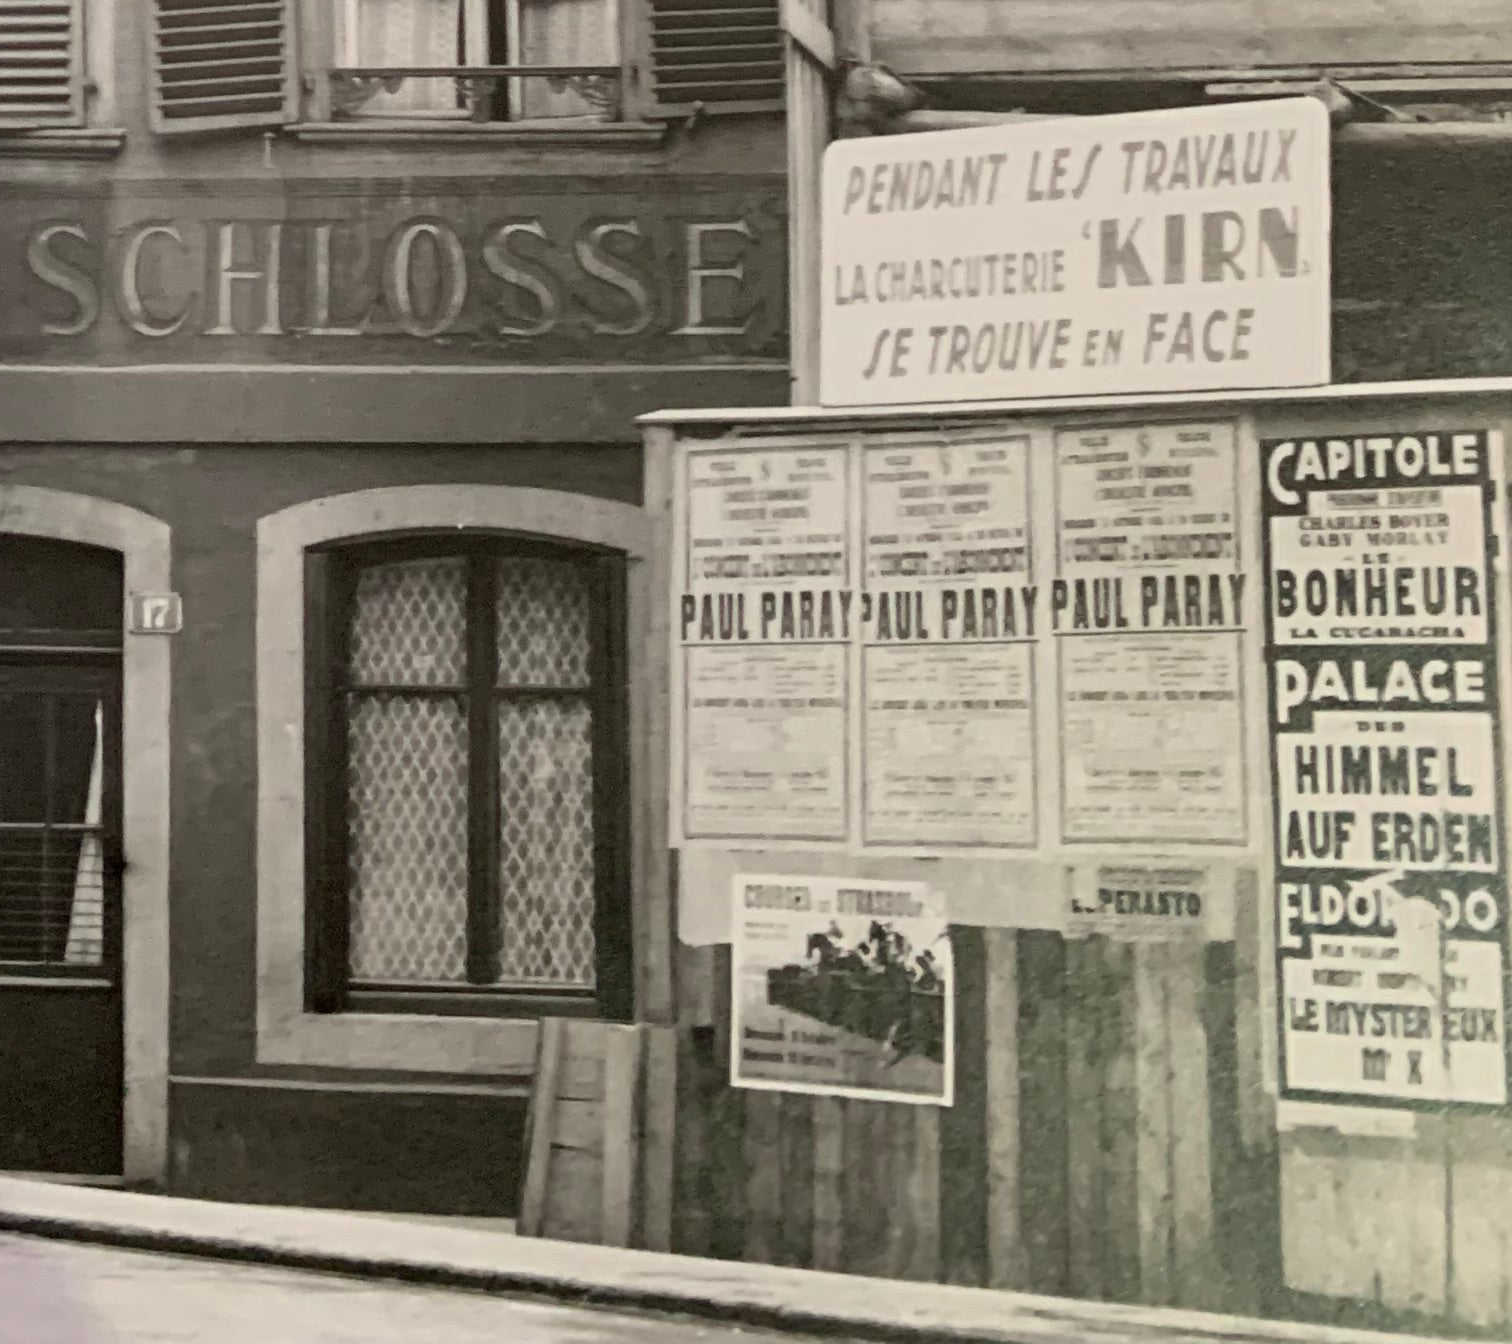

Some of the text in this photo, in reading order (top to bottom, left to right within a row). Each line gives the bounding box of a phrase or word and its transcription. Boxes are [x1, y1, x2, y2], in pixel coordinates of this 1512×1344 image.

[843, 128, 1298, 216] PENDANT LES TRAVAUX
[834, 264, 870, 307] LA
[874, 248, 1066, 301] CHARCUTERIE
[862, 326, 914, 381] SE
[928, 317, 1073, 376] TROUVE
[1142, 307, 1256, 365] FACE
[1267, 434, 1479, 506] CAPITOLE
[1298, 513, 1450, 531] CHARLES BOYER
[1299, 531, 1449, 548] GABY MORLAY
[1361, 552, 1391, 565] LE
[140, 598, 170, 629] 17
[681, 590, 853, 641] PAUL PARAY
[941, 586, 1038, 640] PARAY
[1051, 574, 1246, 630] PAUL PARAY
[1274, 565, 1482, 618] BONHEUR
[1290, 627, 1319, 639] LA
[1274, 659, 1486, 724] PALACE
[1294, 744, 1474, 797] HIMMEL
[1286, 809, 1492, 864] AUF ERDEN
[1280, 882, 1498, 949] ELDODO
[1290, 997, 1498, 1044] LE MYSTEREUX
[1406, 1049, 1423, 1085] X
